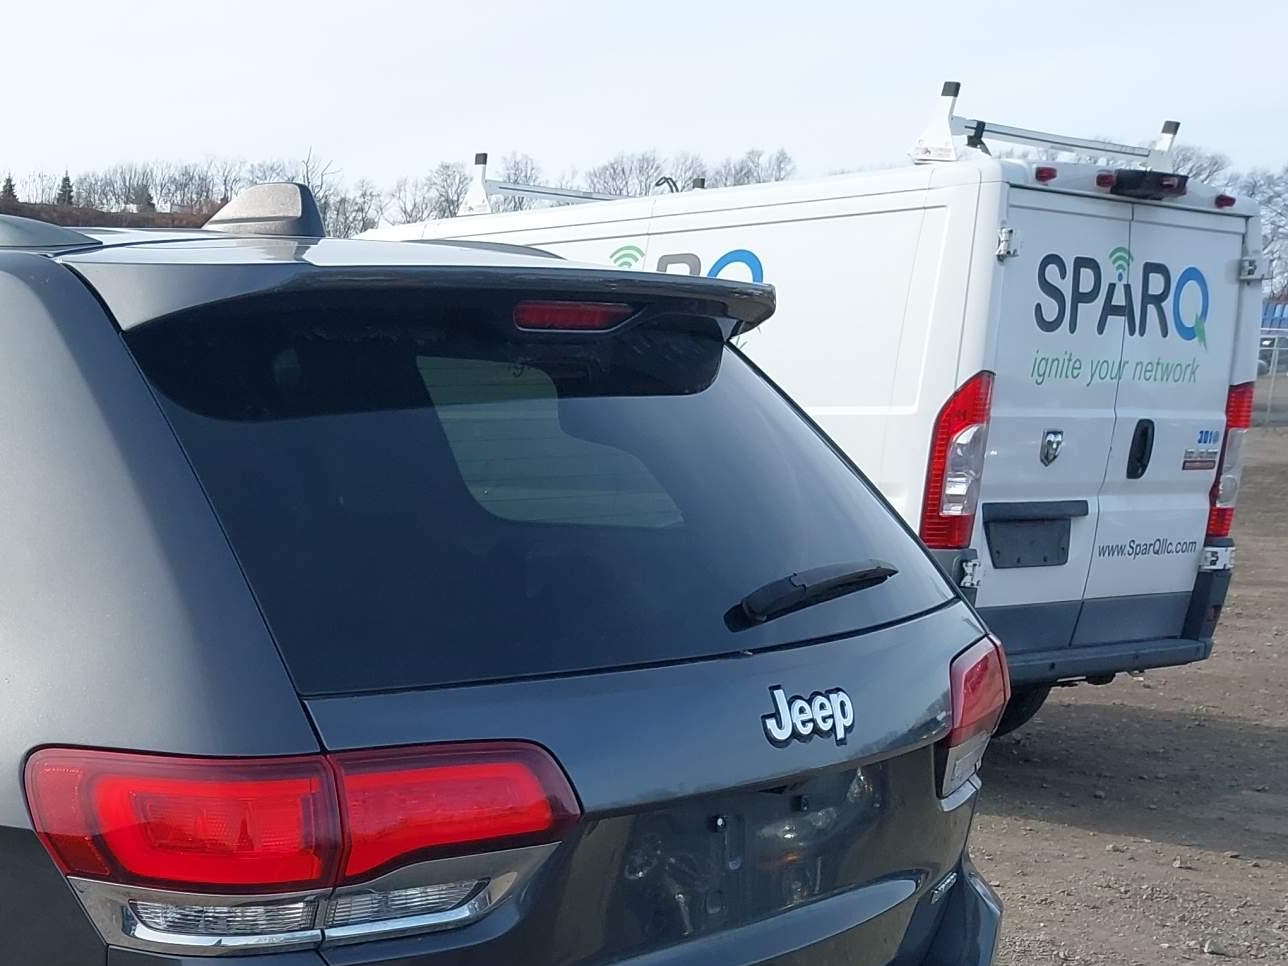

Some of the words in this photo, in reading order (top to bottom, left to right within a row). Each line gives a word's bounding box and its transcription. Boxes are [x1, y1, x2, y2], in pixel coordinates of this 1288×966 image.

[1034, 252, 1209, 349] SPARQ
[1031, 350, 1082, 386] ignite
[1086, 358, 1129, 387] your
[1132, 357, 1200, 384] network
[1097, 538, 1197, 560] www.SparQllc.com
[761, 685, 855, 748] Jeep
